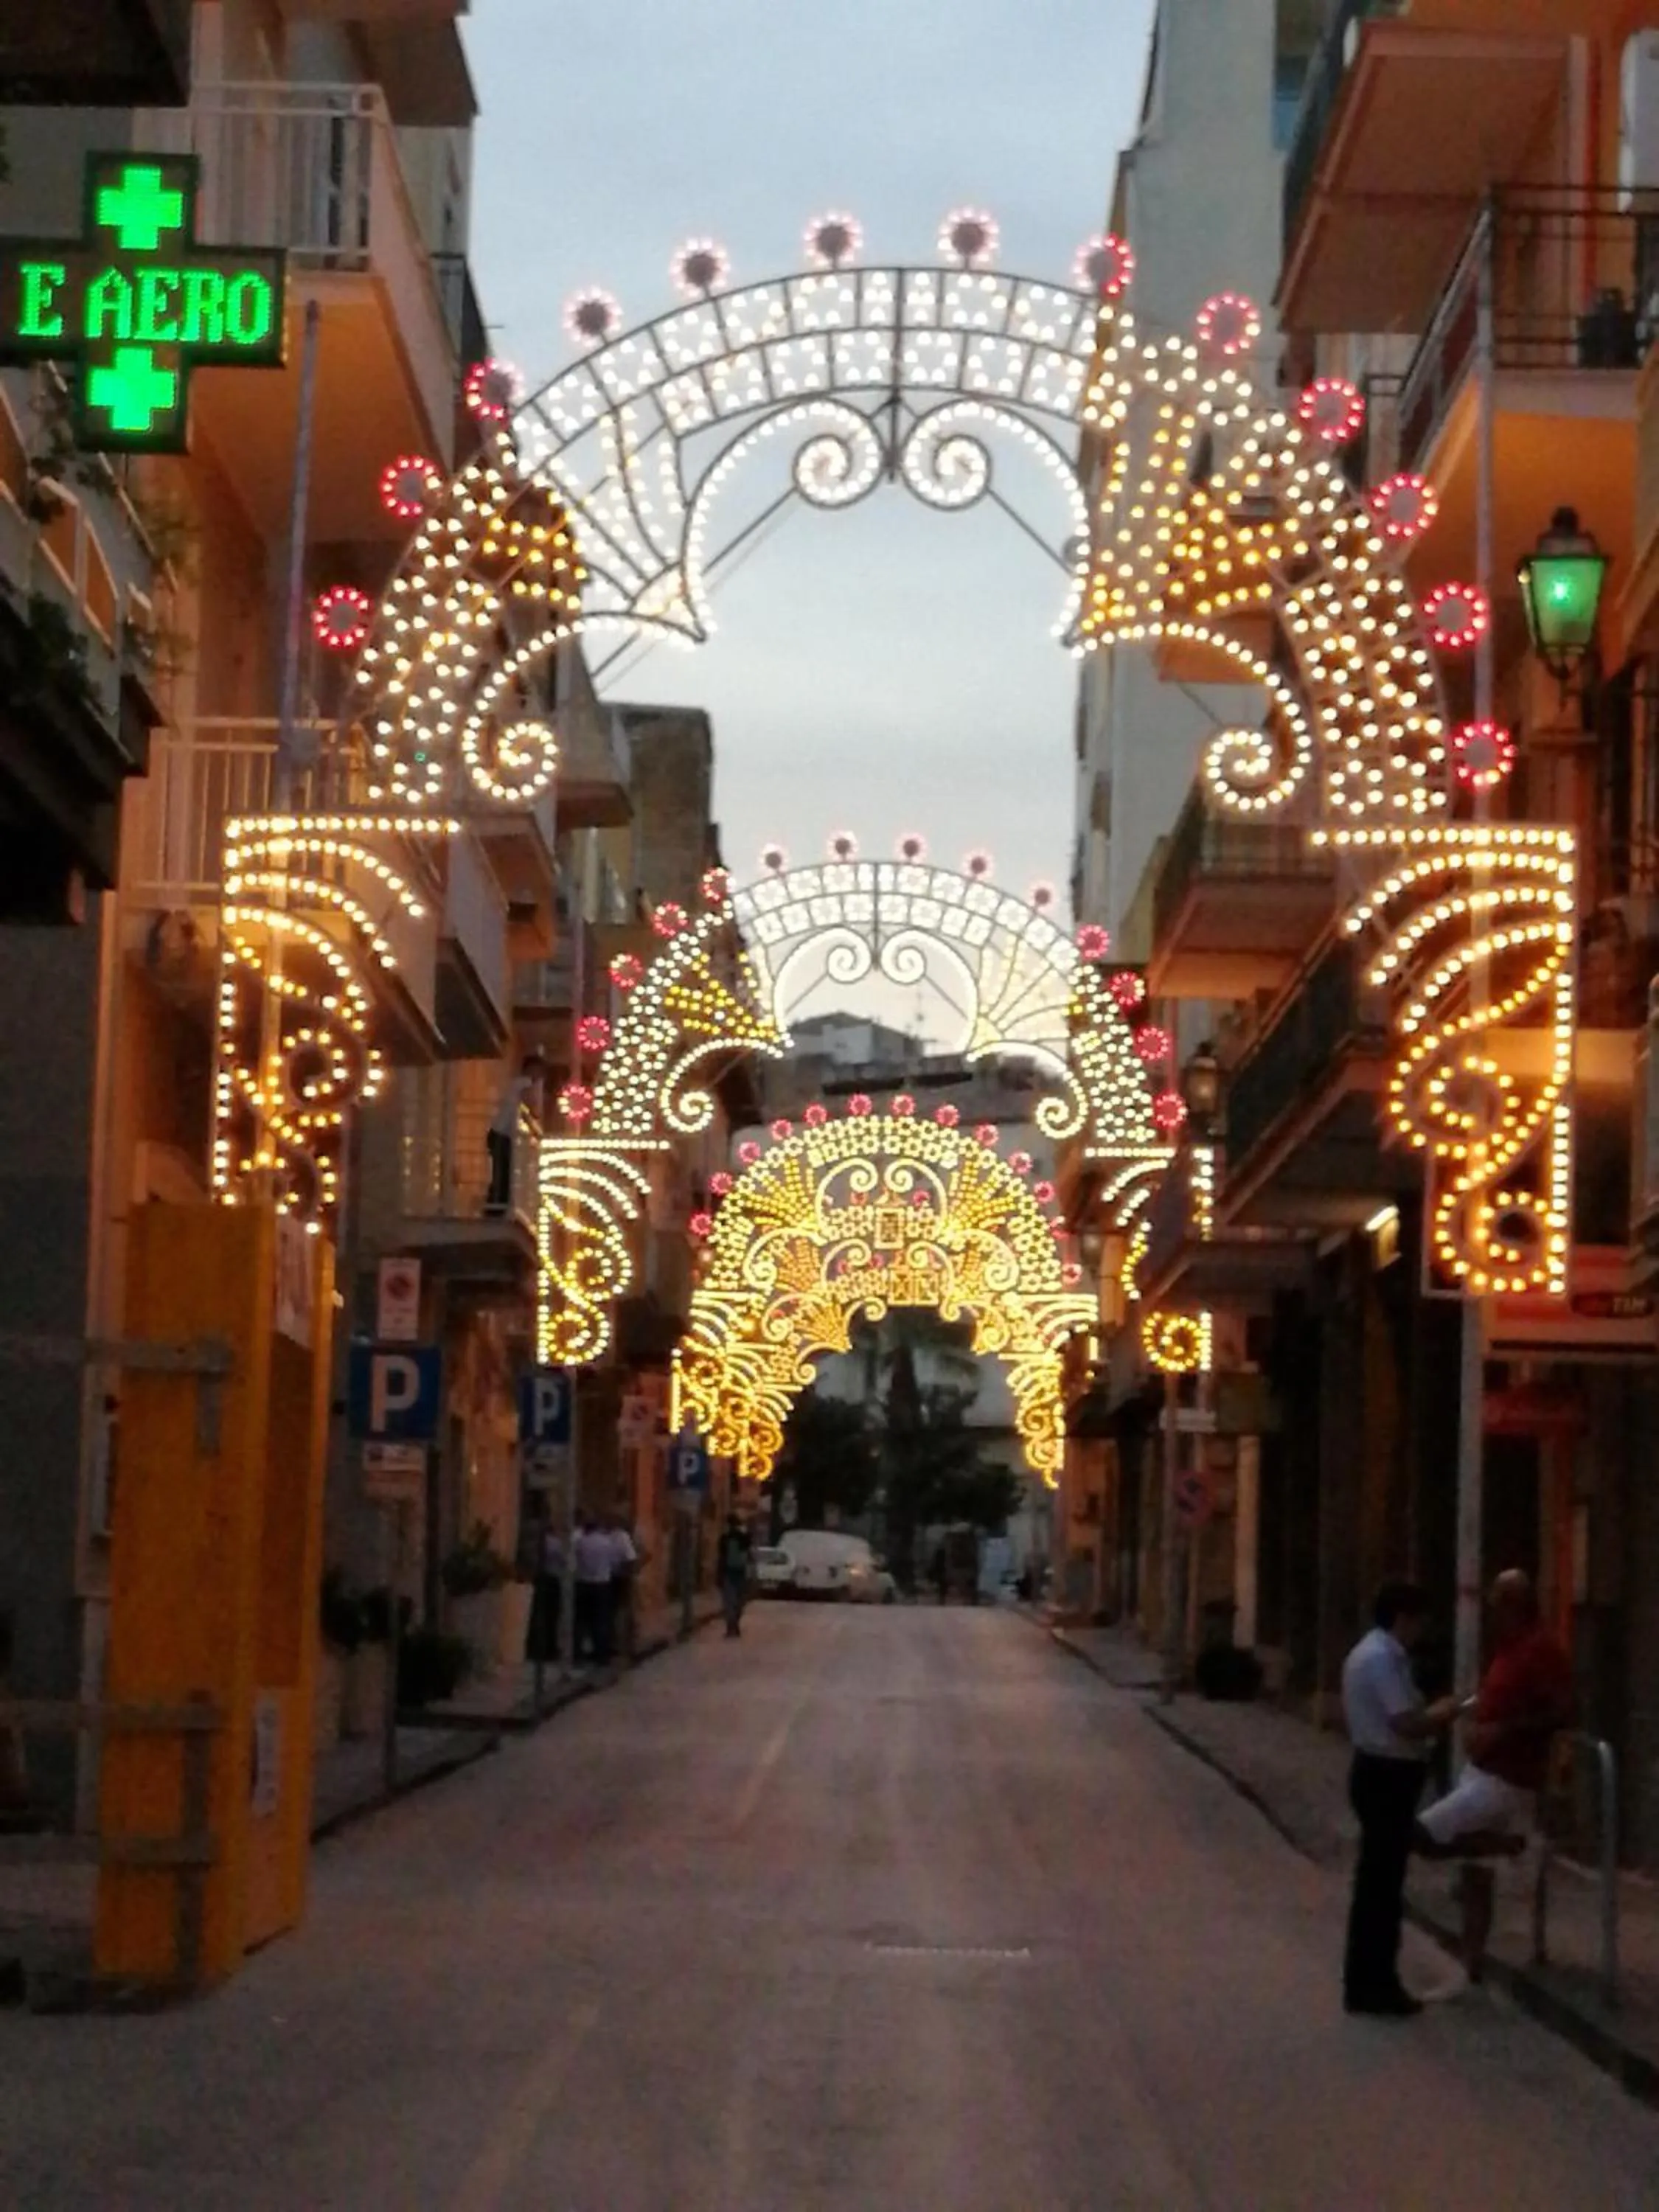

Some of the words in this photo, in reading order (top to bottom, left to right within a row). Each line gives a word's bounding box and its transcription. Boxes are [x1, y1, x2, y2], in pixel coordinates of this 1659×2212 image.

[18, 263, 66, 337] E
[84, 265, 272, 344] AERO
[371, 1354, 420, 1433] P
[534, 1377, 560, 1436] P
[678, 1452, 700, 1484] P
